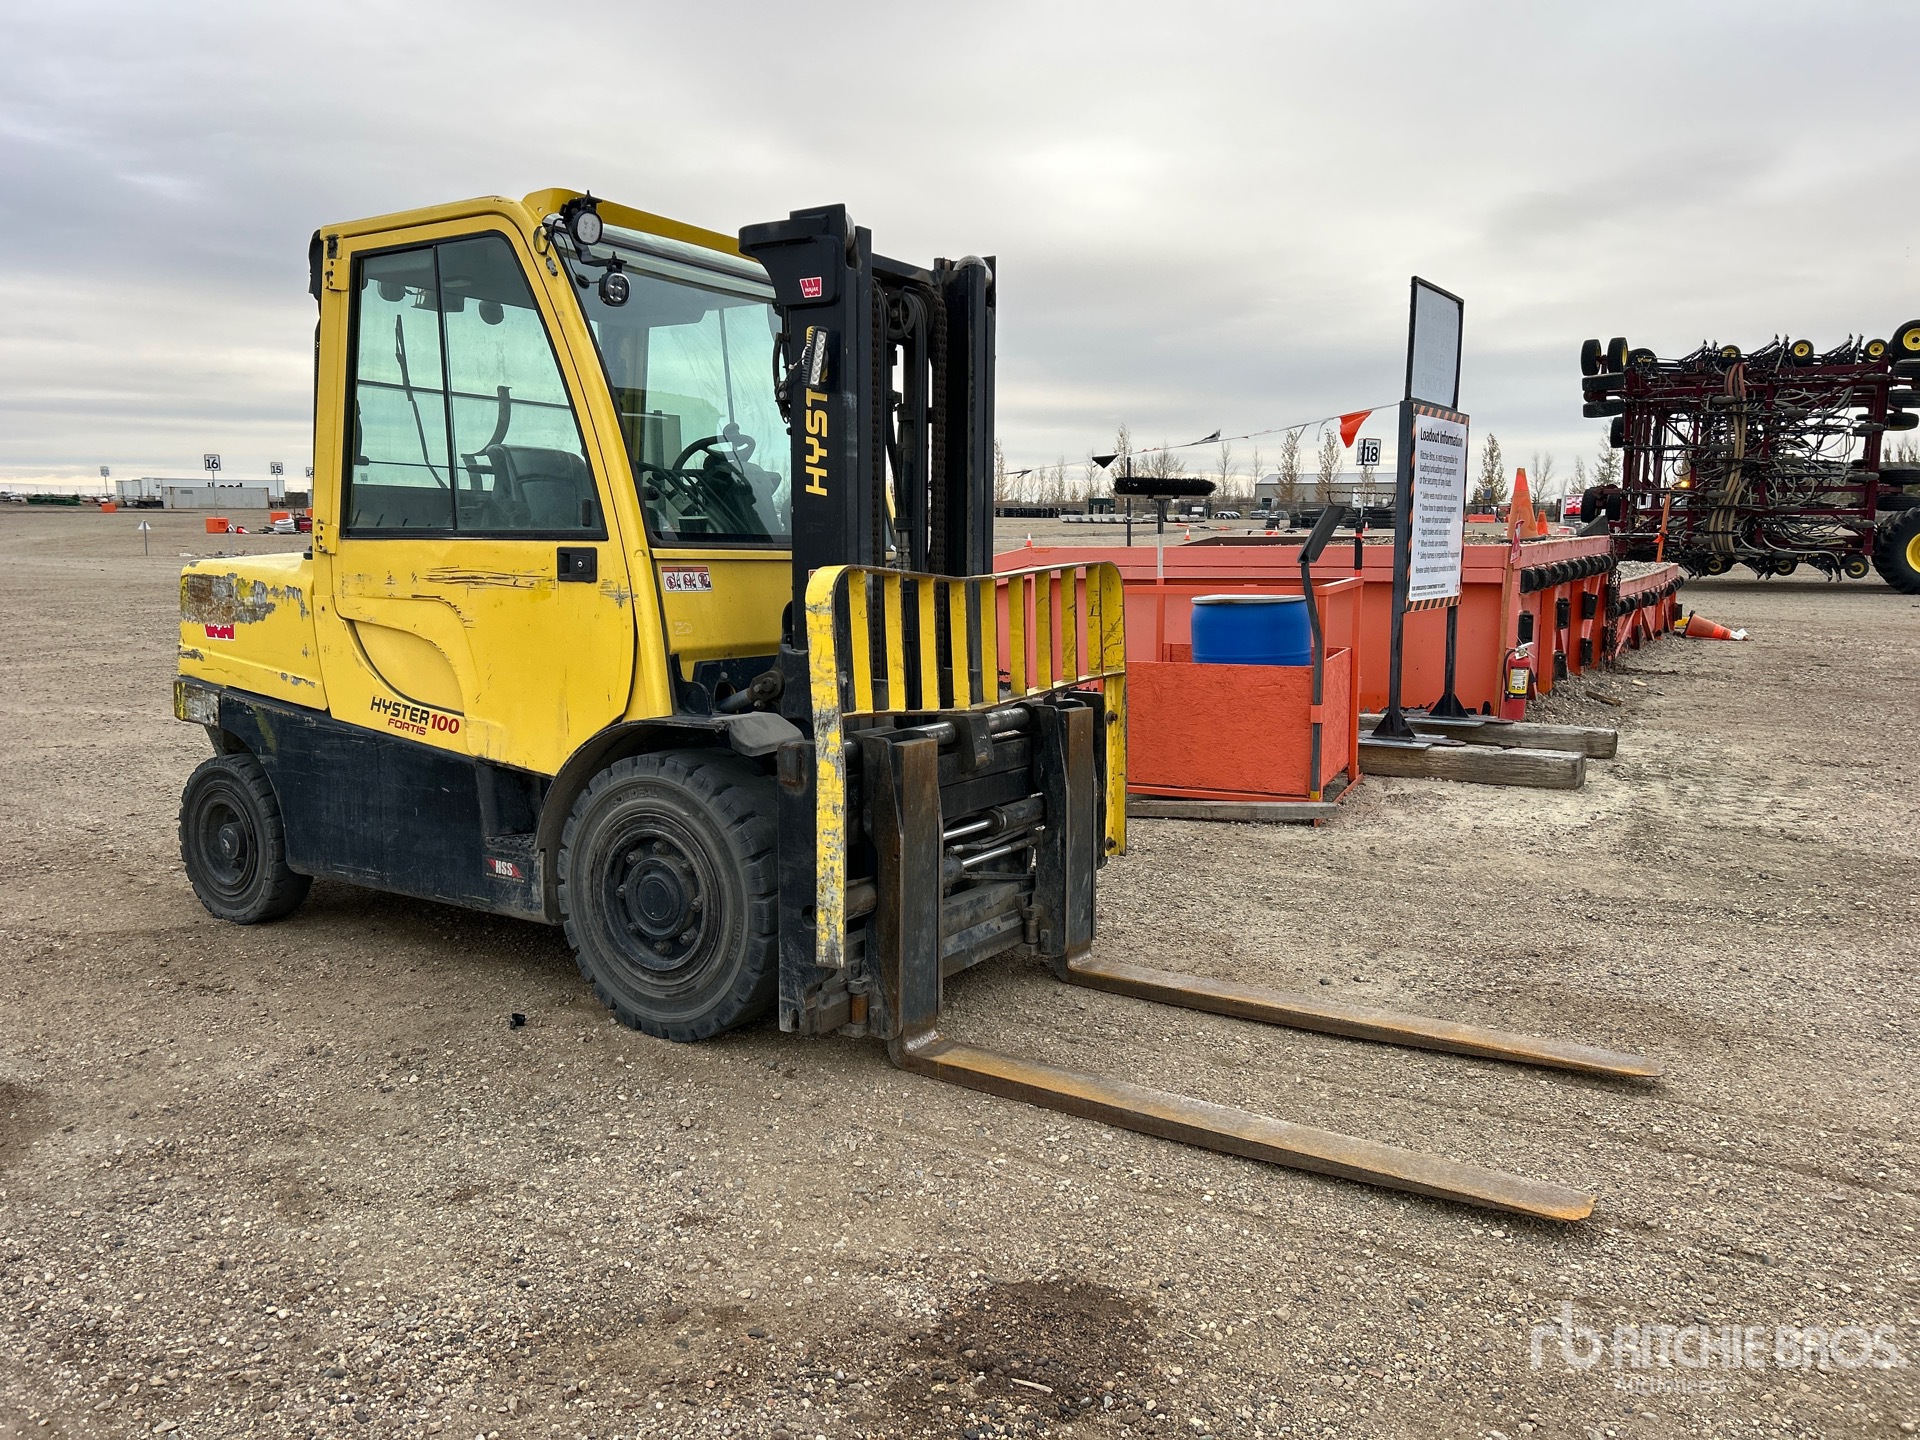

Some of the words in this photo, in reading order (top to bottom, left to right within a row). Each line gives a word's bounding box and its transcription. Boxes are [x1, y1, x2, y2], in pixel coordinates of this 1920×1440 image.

[1420, 427, 1440, 444] Loadout
[1440, 430, 1463, 448] Information
[1365, 446, 1379, 463] 18
[205, 459, 219, 469] 16
[271, 465, 282, 474] 15
[370, 696, 430, 726] HYSTER
[431, 713, 460, 735] 100
[387, 718, 427, 736] FORTIS
[495, 859, 513, 877] HSS
